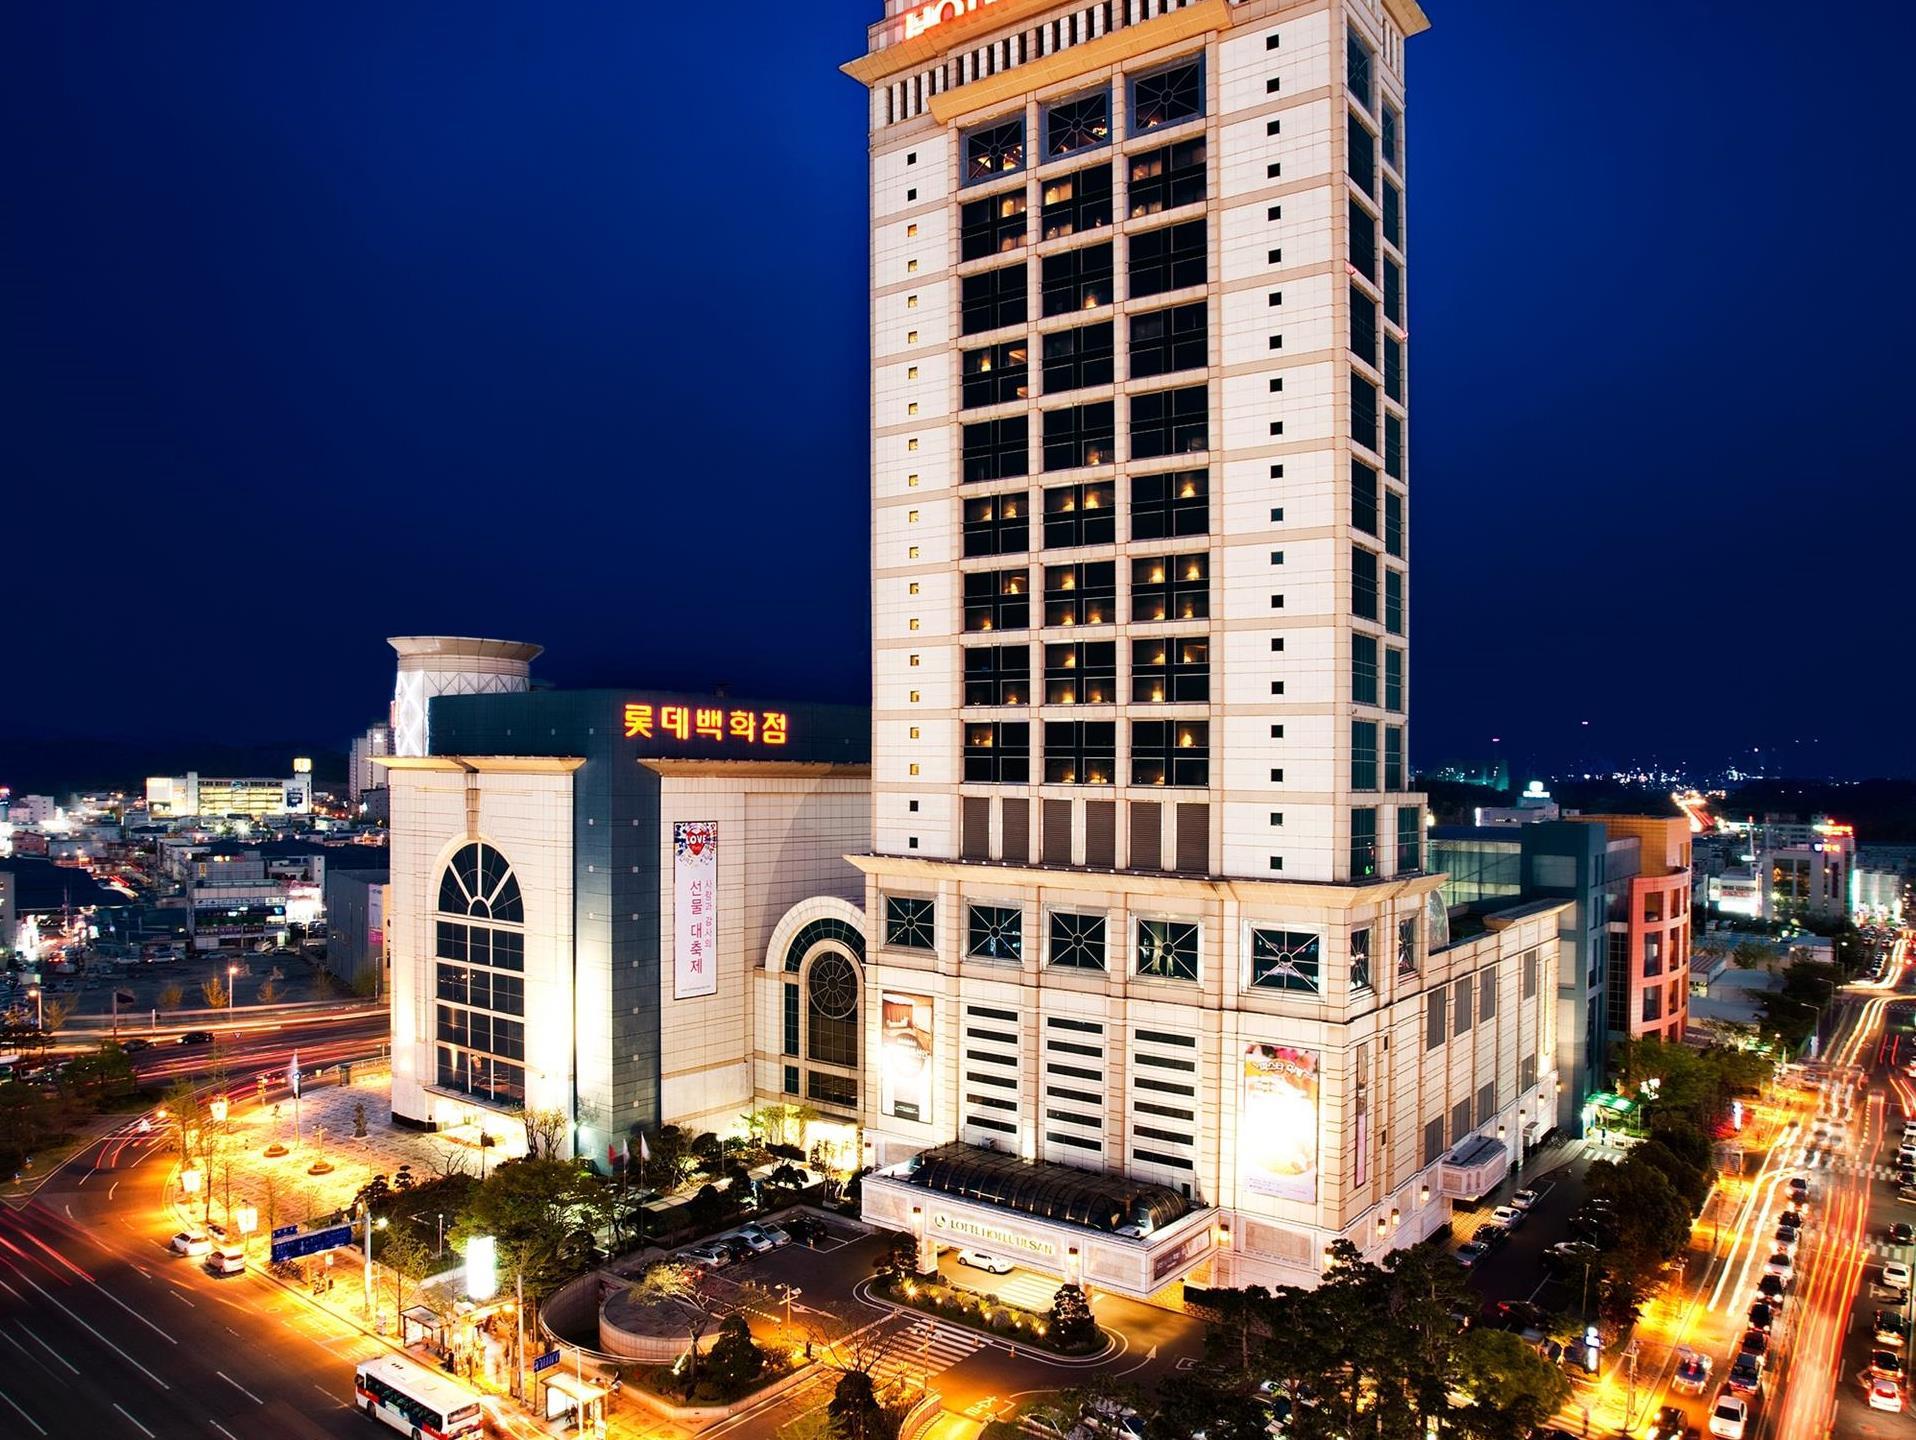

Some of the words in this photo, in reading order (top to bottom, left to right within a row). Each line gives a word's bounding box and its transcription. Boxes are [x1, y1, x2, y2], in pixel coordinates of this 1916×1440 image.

[624, 703, 787, 745] 롯데백화점
[685, 833, 710, 845] LOVE
[690, 880, 703, 916] 선물
[690, 922, 703, 975] 대축제
